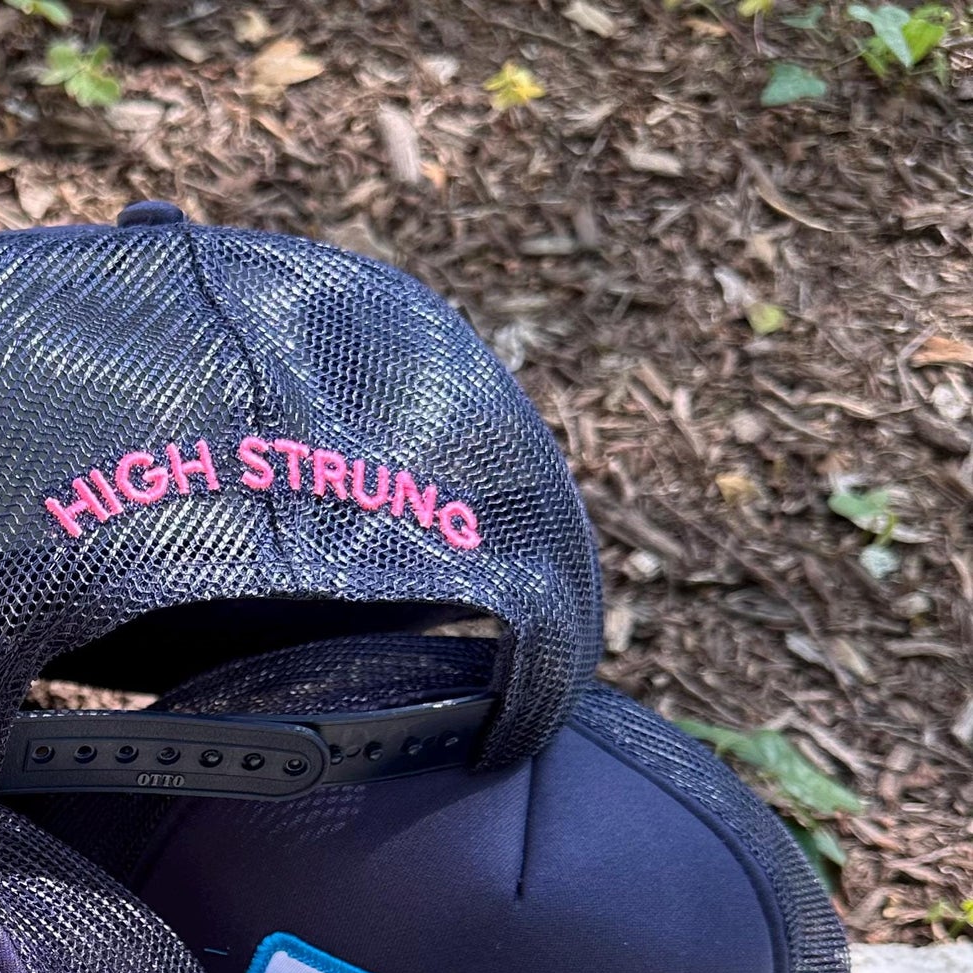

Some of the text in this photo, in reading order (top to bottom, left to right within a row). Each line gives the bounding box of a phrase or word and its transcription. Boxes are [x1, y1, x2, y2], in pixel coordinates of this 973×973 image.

[45, 436, 482, 551] HIGH STRUNG
[136, 772, 185, 788] OTTO
